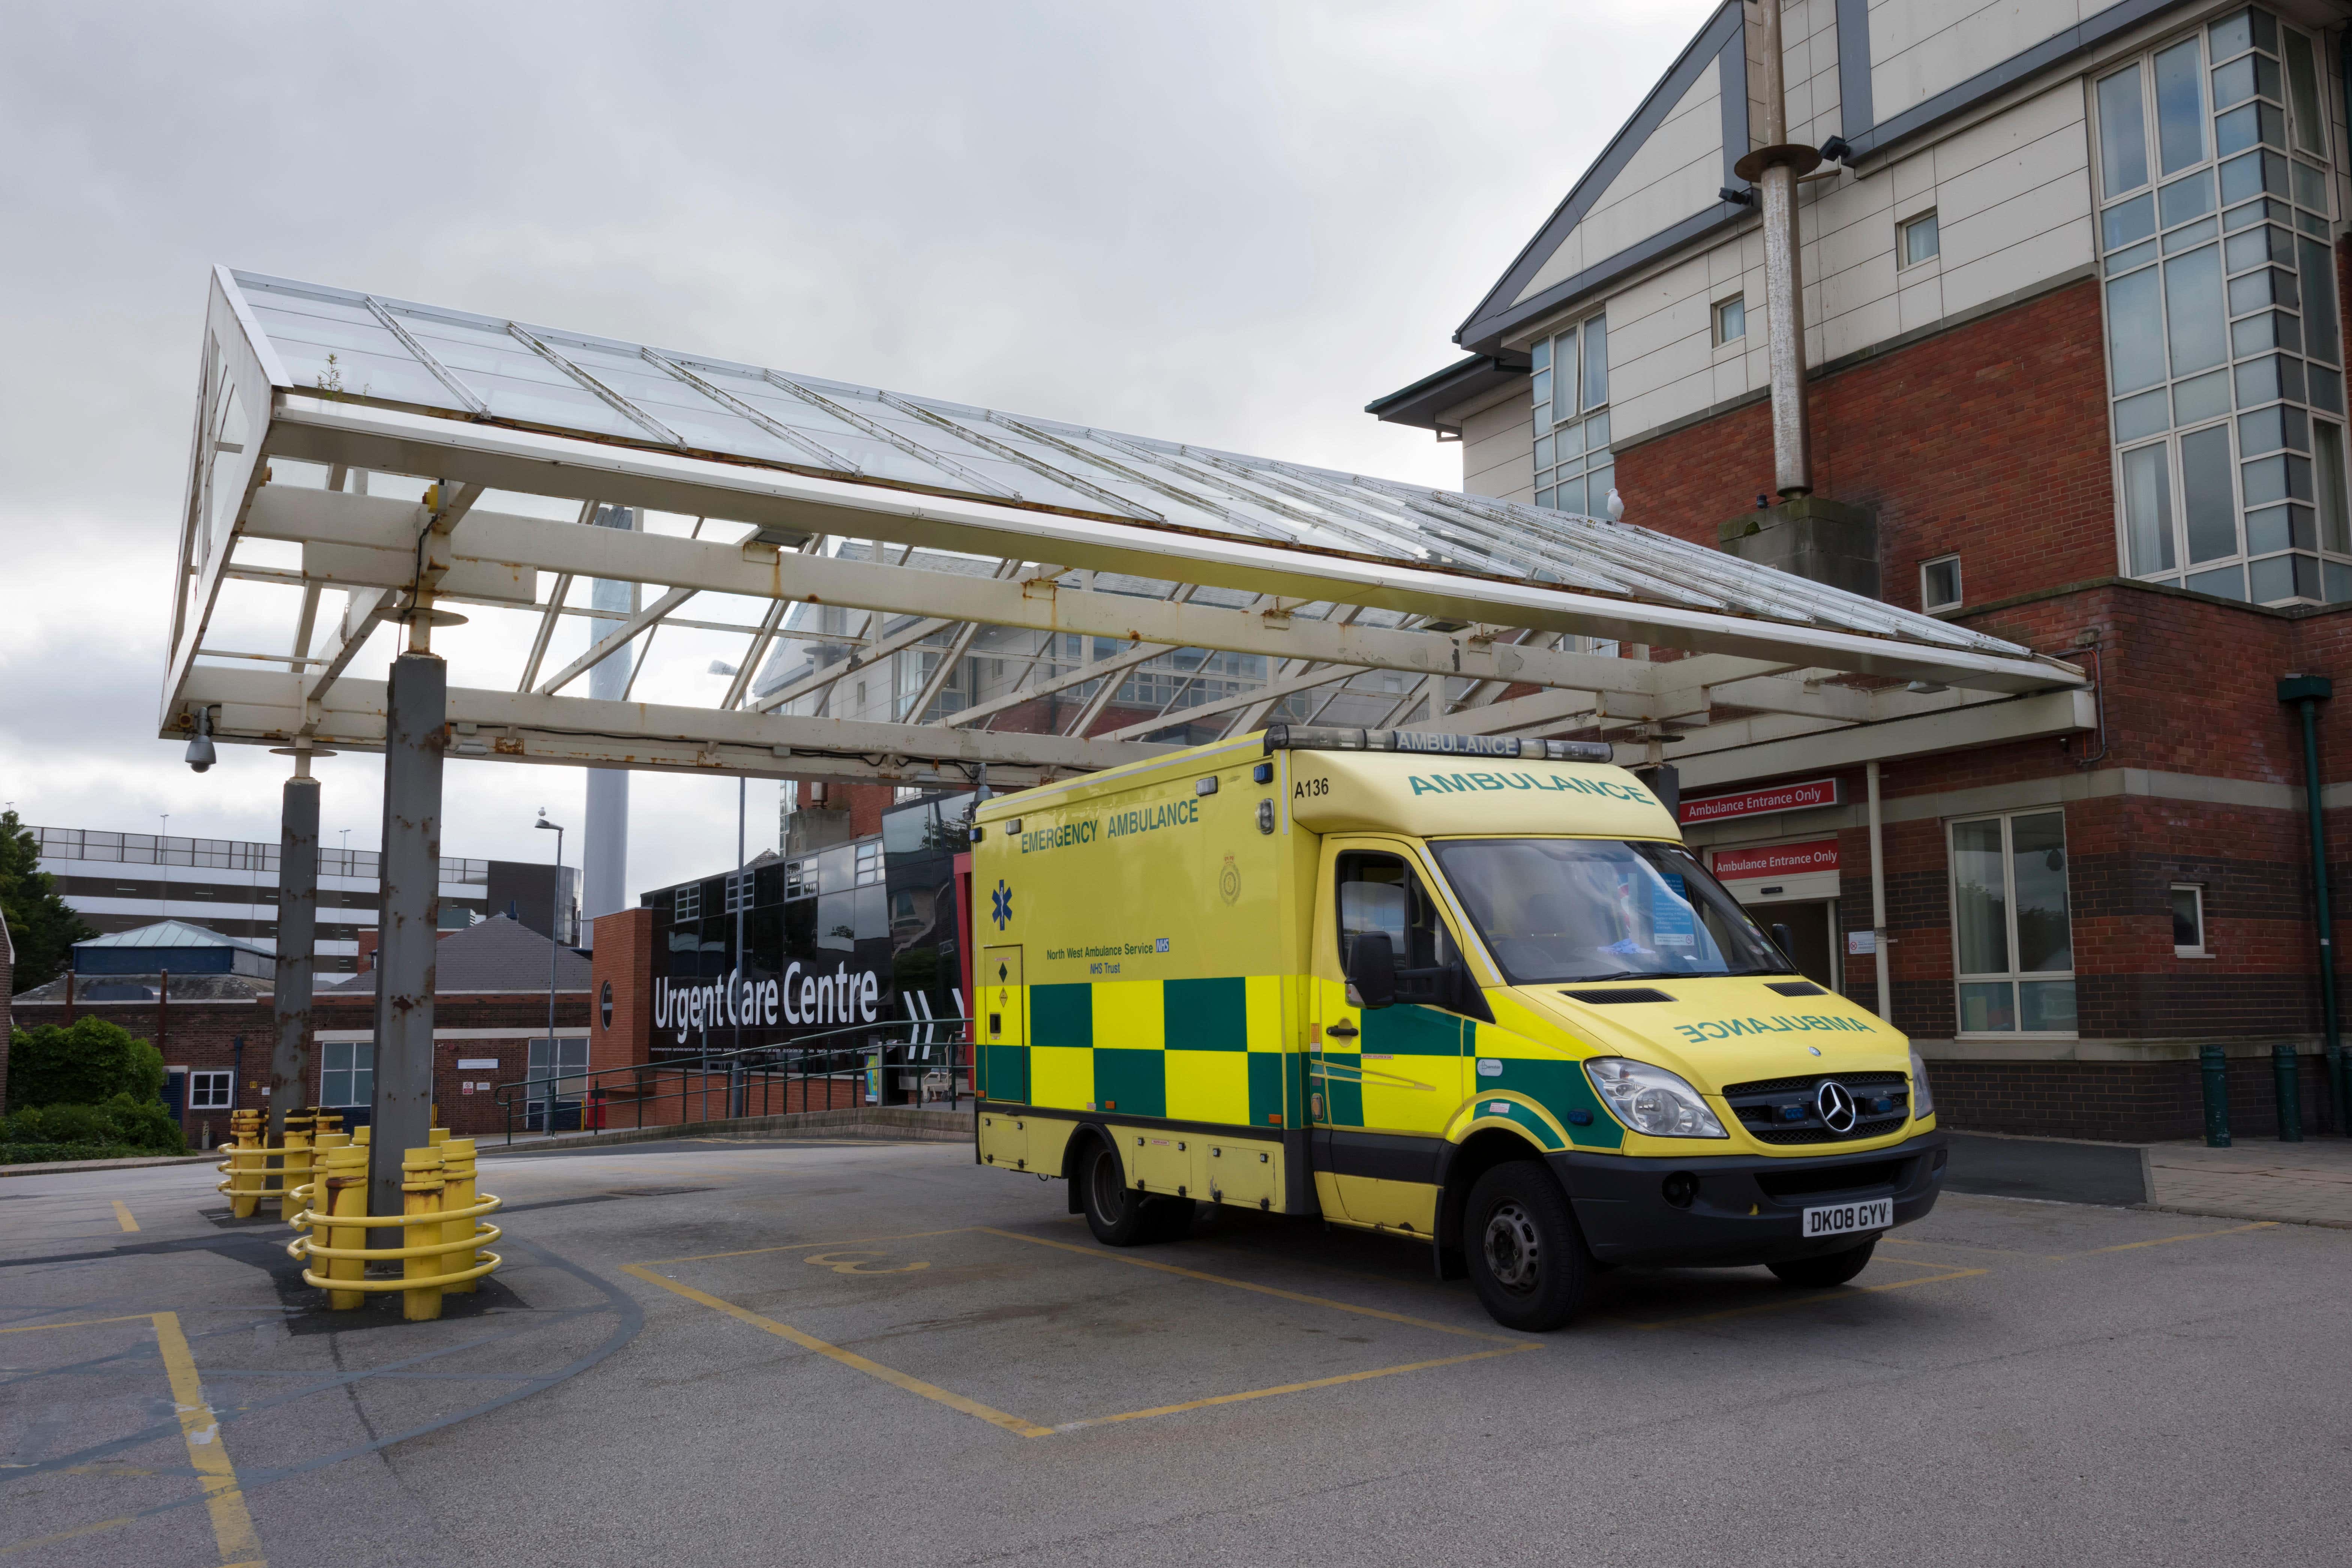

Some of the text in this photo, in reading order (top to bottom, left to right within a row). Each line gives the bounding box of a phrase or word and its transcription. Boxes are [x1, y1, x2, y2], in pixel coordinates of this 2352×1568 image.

[1397, 732, 1518, 755] AMBULANCE
[1294, 778, 1329, 799] A136
[1408, 772, 1656, 805] AMBULANCE
[1689, 788, 1821, 817] Ambulance Entrance Only
[1022, 799, 1199, 854] EMERGENCY AMBULANCE
[1716, 850, 1837, 872] Ambulance Entrance Only
[1047, 939, 1169, 960] North West Ambulance Service NHS
[1090, 963, 1120, 974] NHS Trust
[655, 961, 877, 1043] Urgent Care Centre
[1811, 1202, 1886, 1232] DK08 GYV
